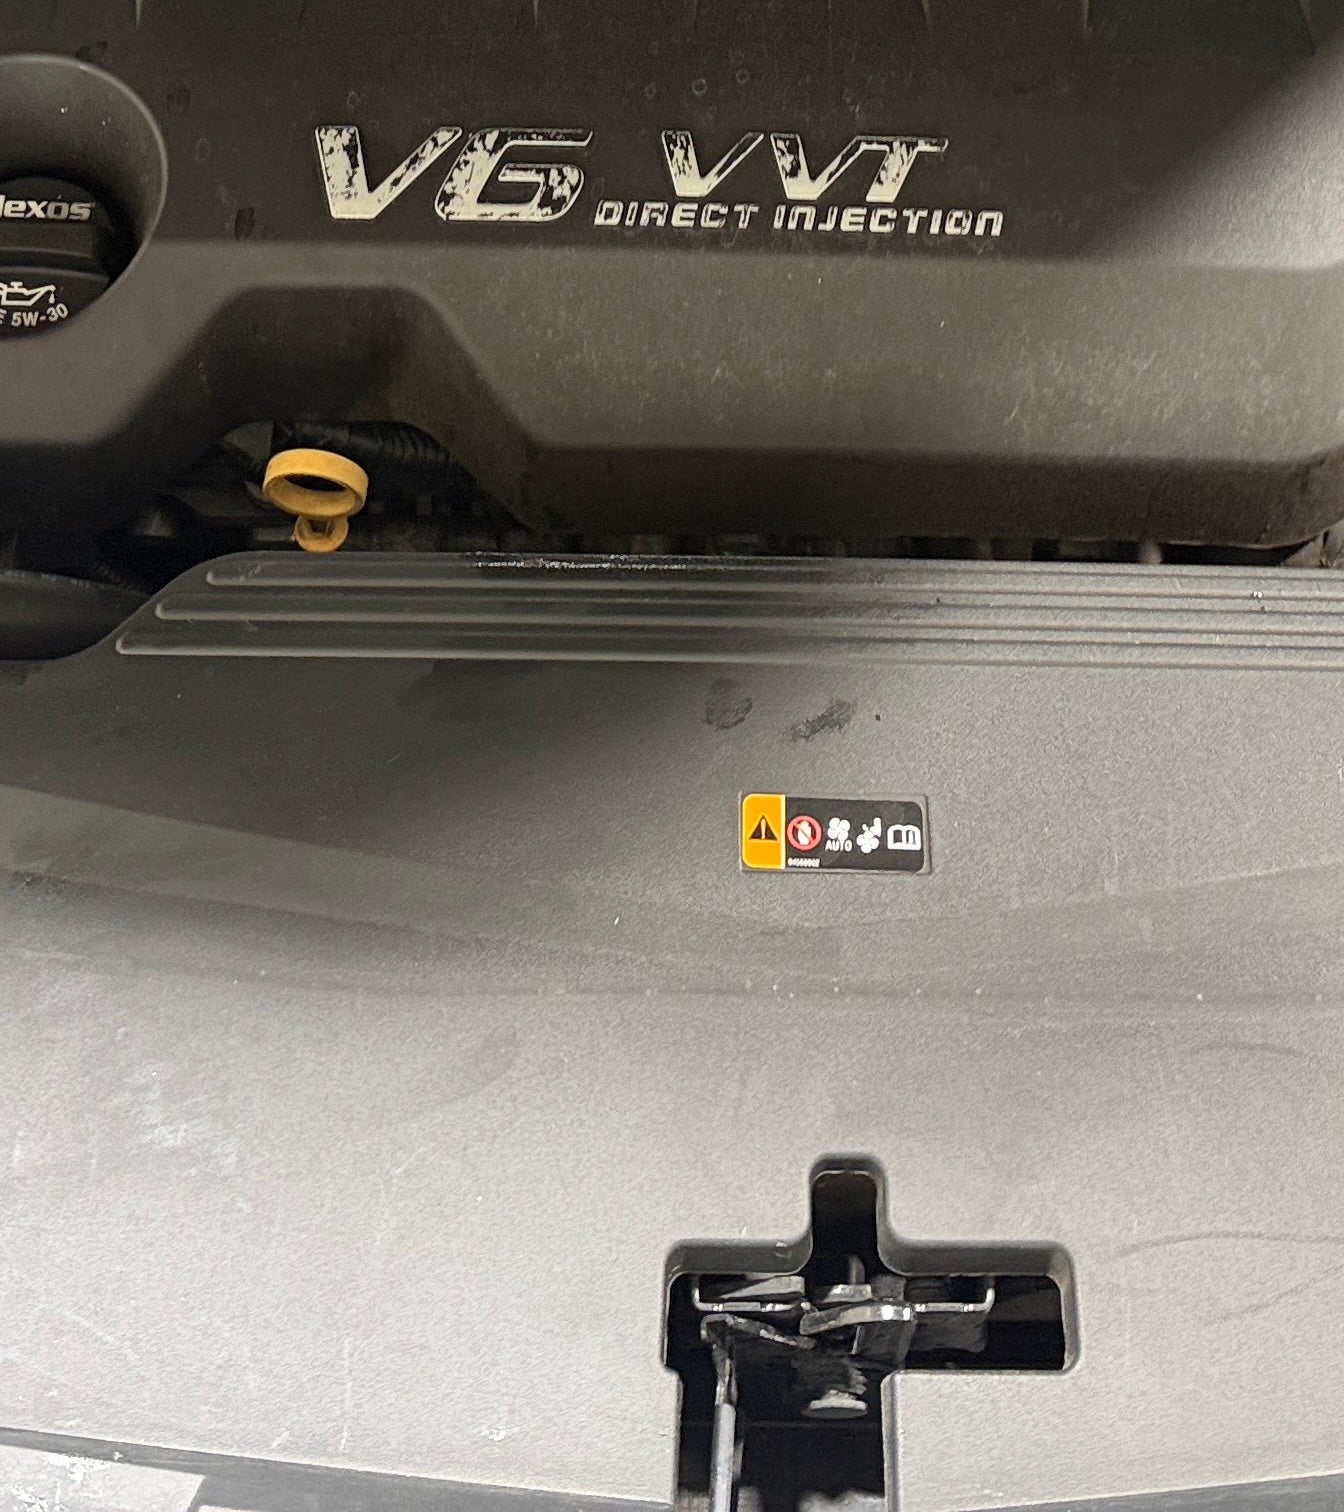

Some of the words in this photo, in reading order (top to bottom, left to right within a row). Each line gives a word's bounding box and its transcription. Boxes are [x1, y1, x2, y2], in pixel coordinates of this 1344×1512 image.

[314, 125, 593, 221] V6
[660, 129, 948, 202] VVT
[593, 199, 758, 229] DIRECT
[773, 202, 1004, 237] INJECTION
[11, 303, 69, 328] 5W-30
[824, 839, 853, 853] AUTO
